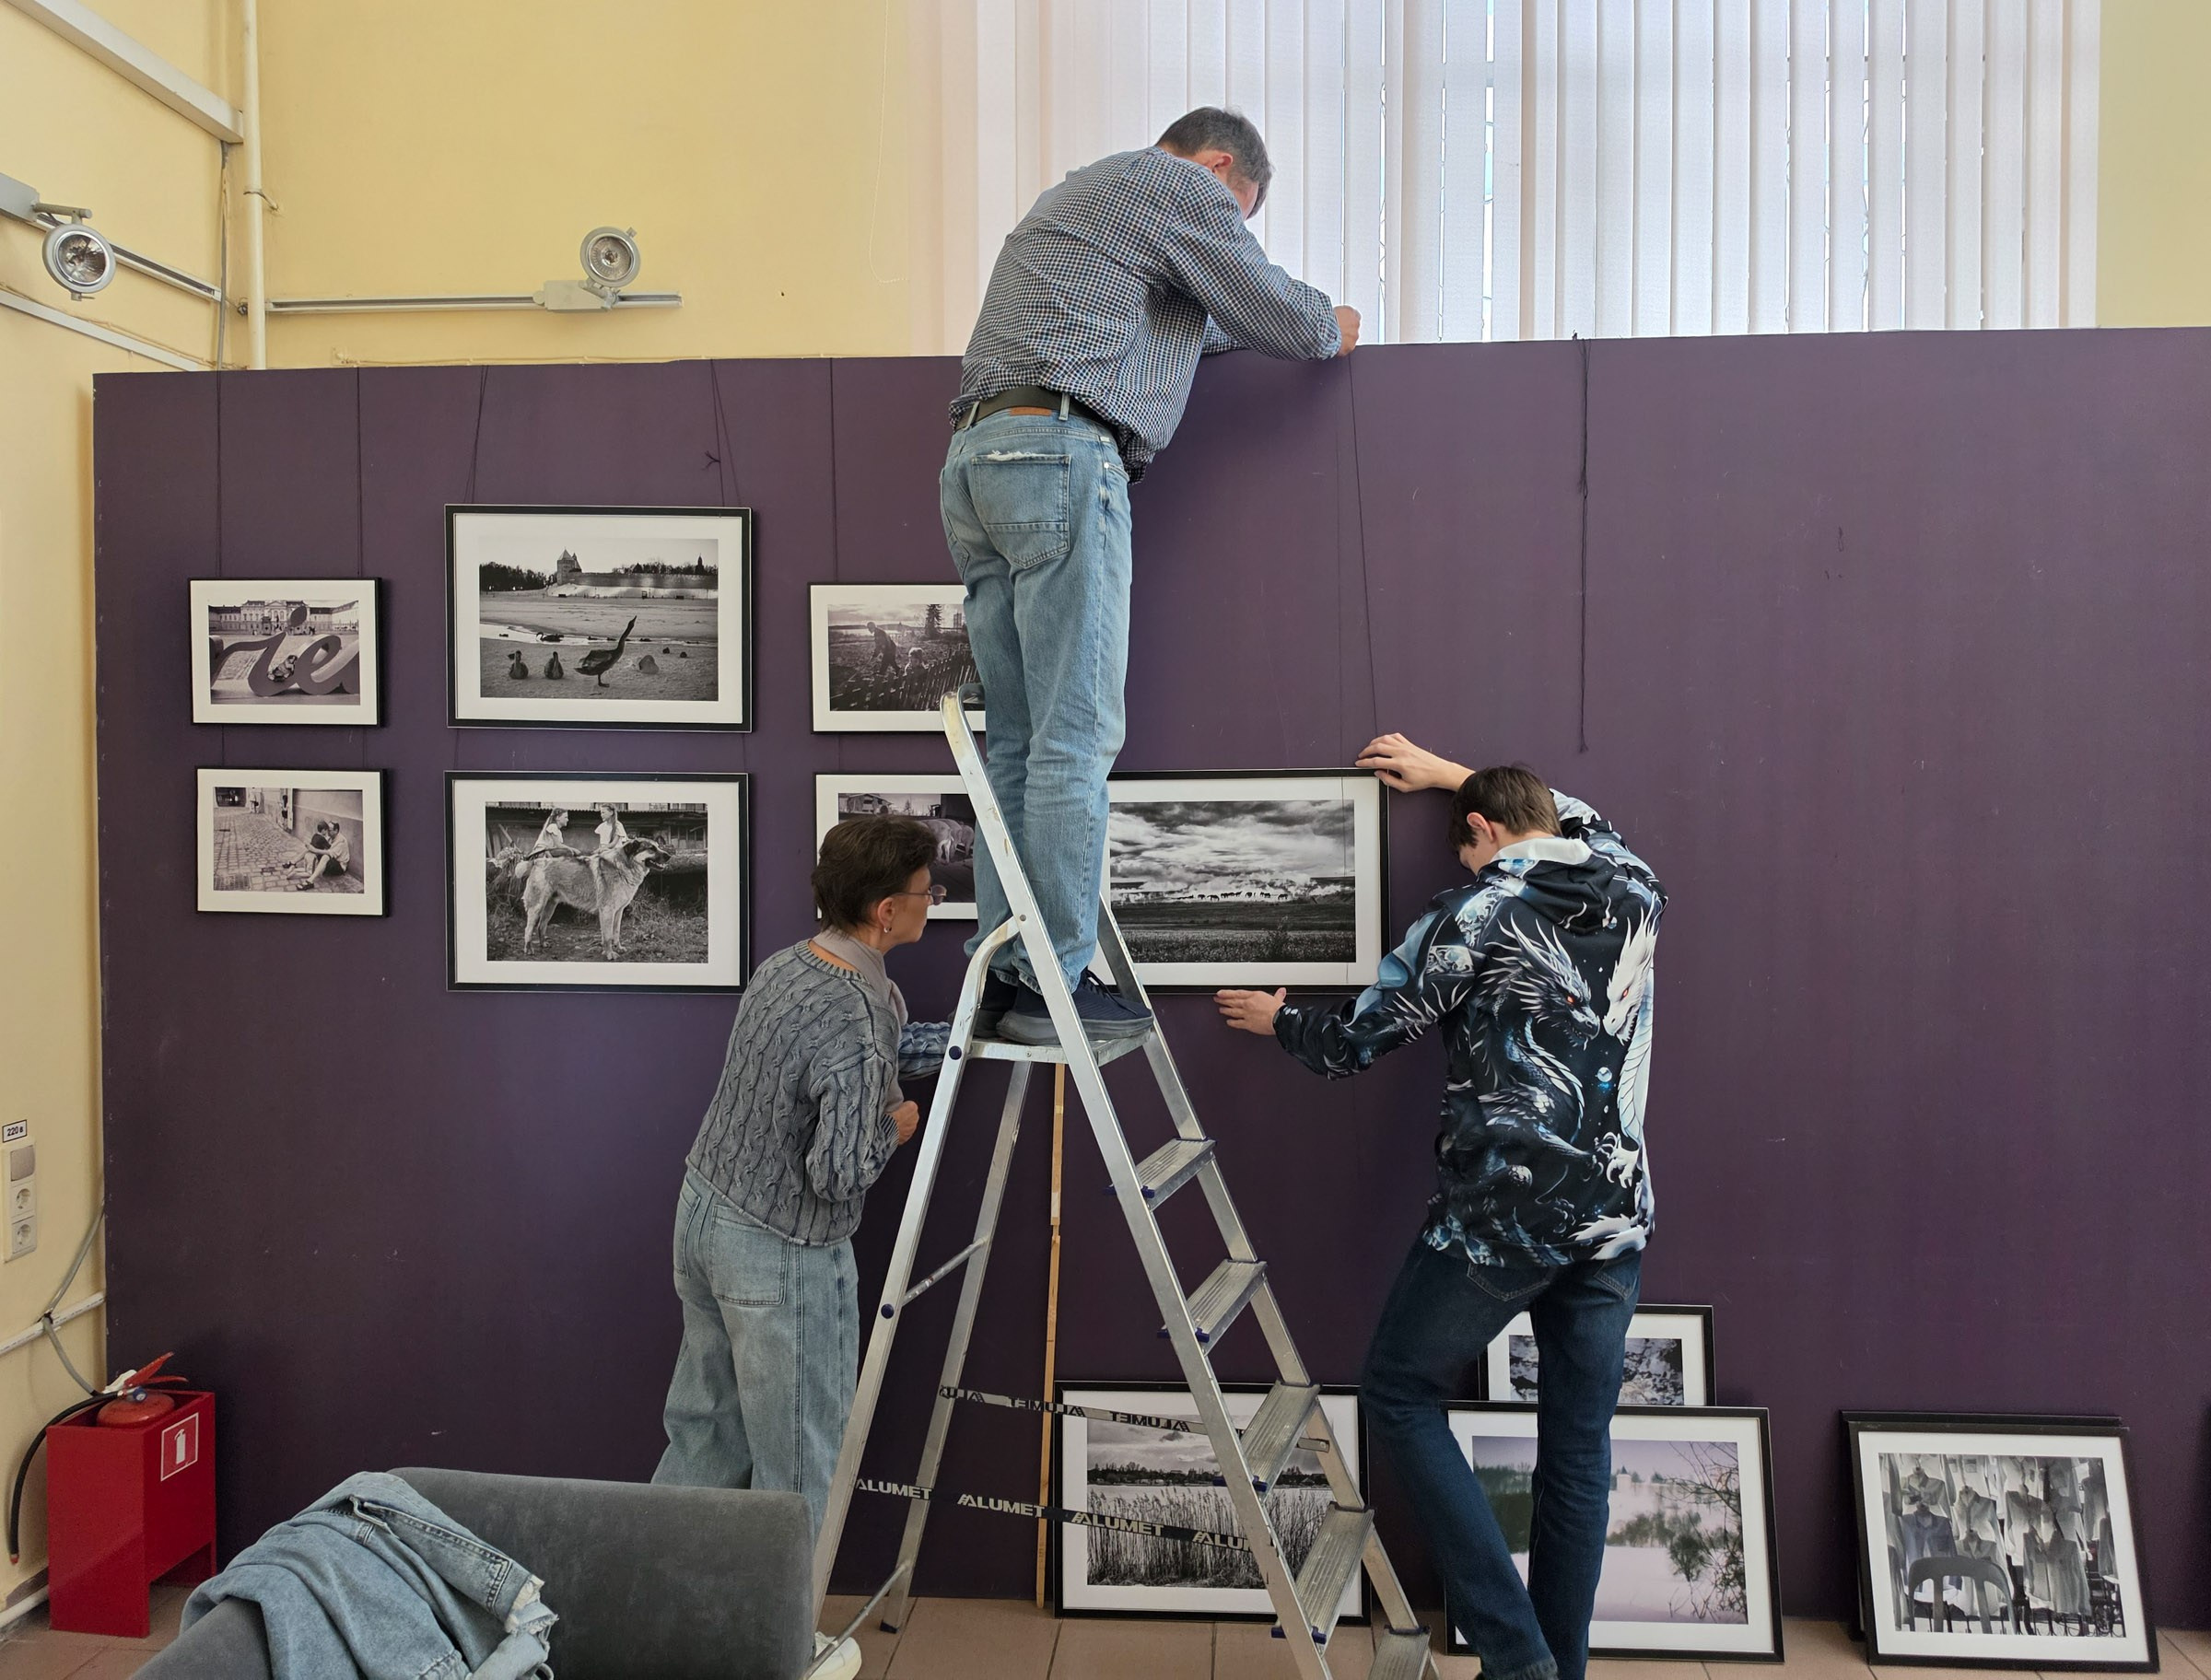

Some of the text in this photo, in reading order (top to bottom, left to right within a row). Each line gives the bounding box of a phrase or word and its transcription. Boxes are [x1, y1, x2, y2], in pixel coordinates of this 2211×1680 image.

[856, 1478, 932, 1500] ALUMET
[958, 1493, 1045, 1518] ALUMET
[1071, 1511, 1164, 1536] ALUMET
